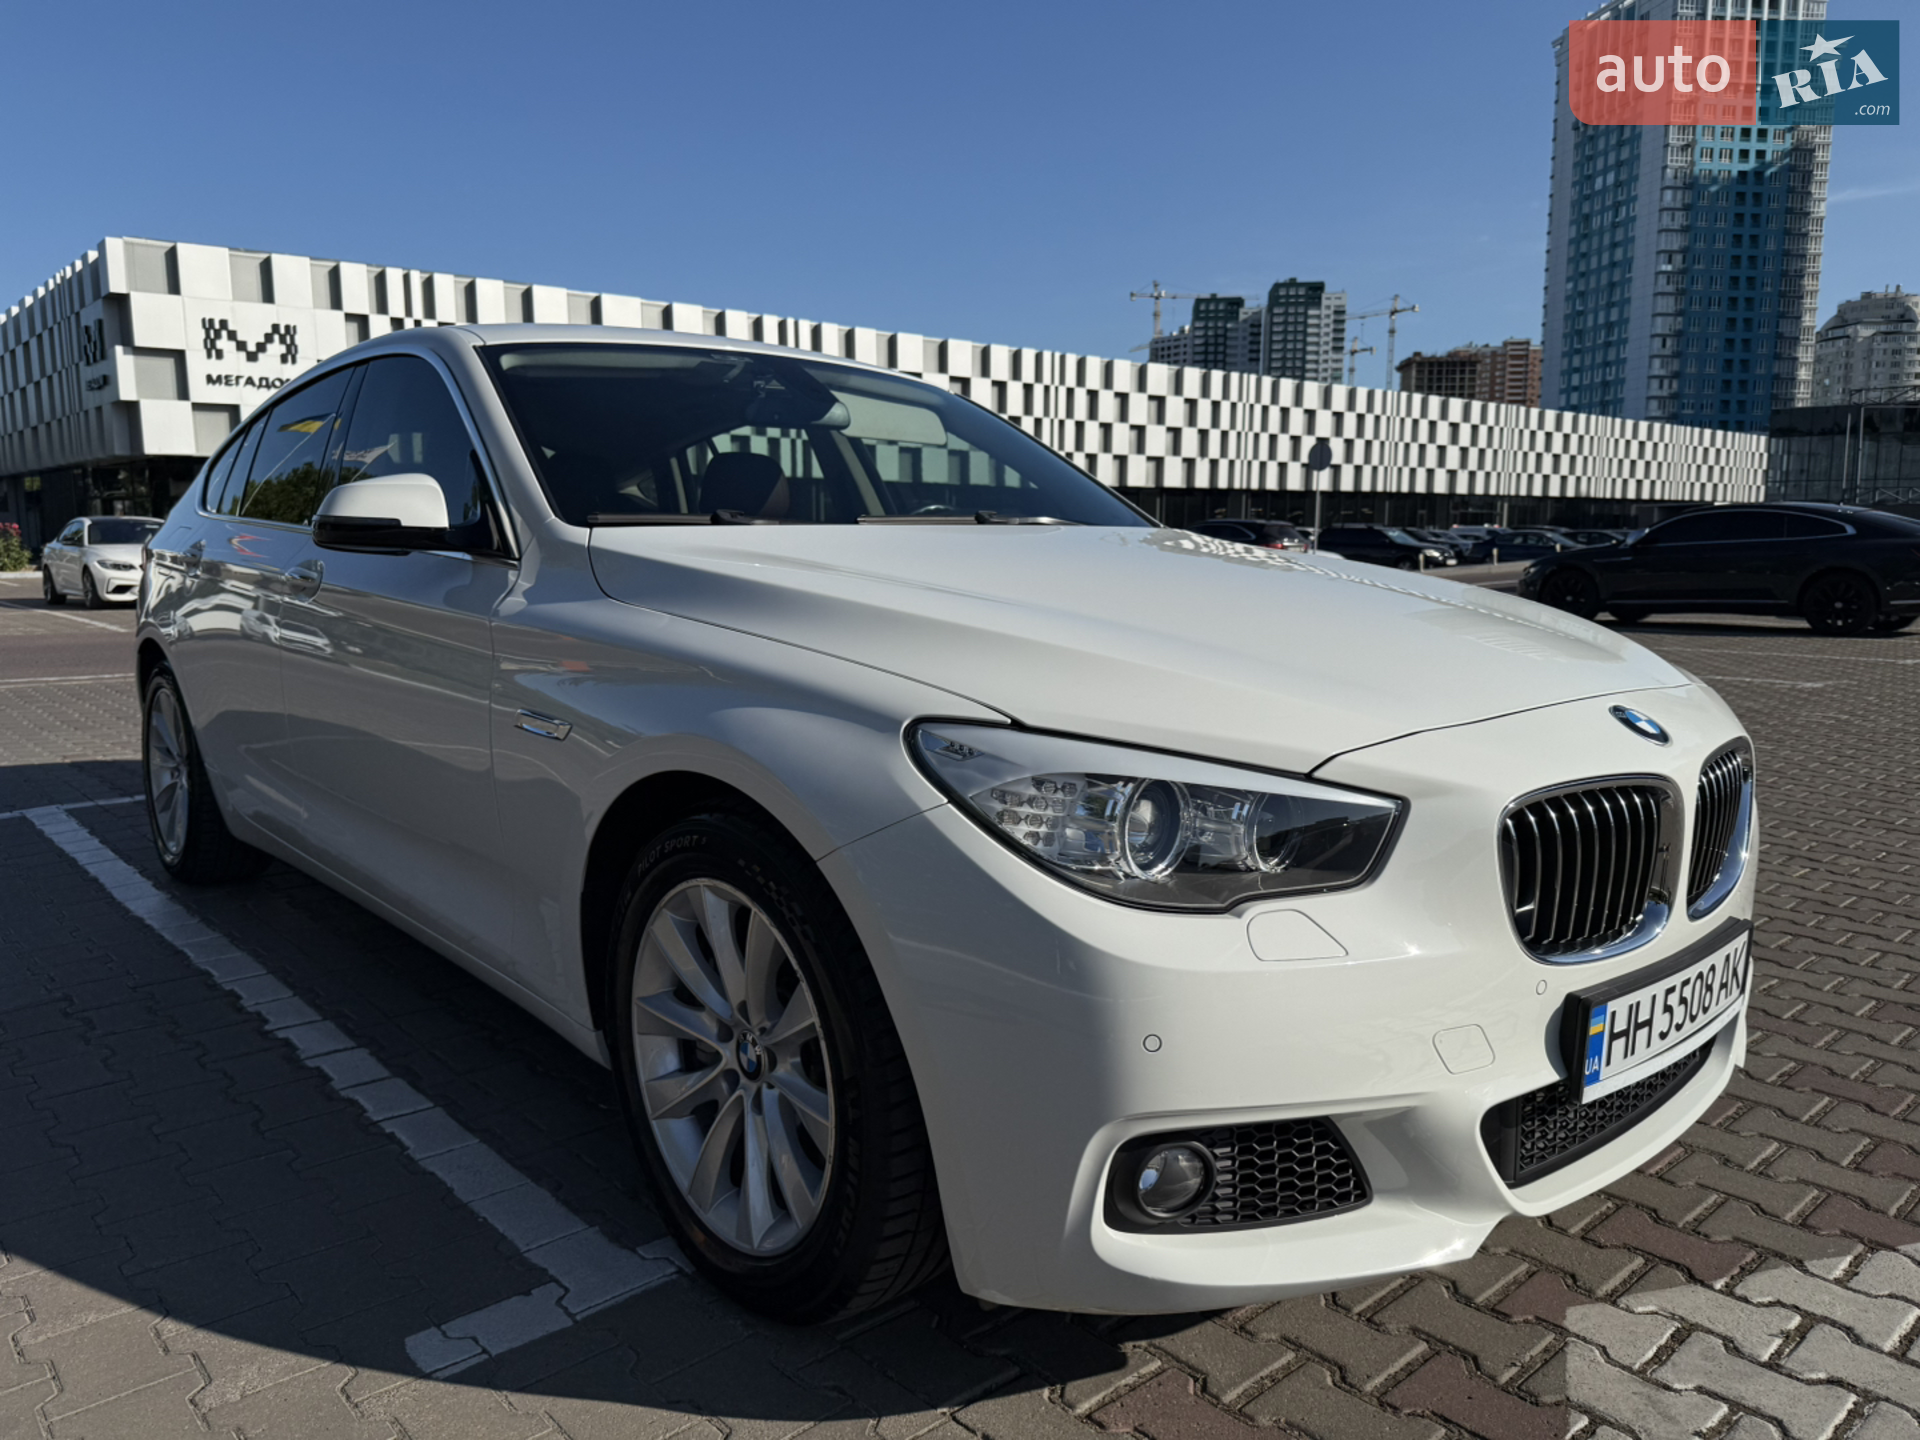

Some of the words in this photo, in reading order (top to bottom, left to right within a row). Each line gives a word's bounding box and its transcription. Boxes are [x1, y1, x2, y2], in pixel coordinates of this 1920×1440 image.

[206, 374, 291, 391] МЕГАДО
[637, 846, 662, 878] PILOT
[664, 834, 699, 853] SPORT
[1585, 1058, 1600, 1075] UA
